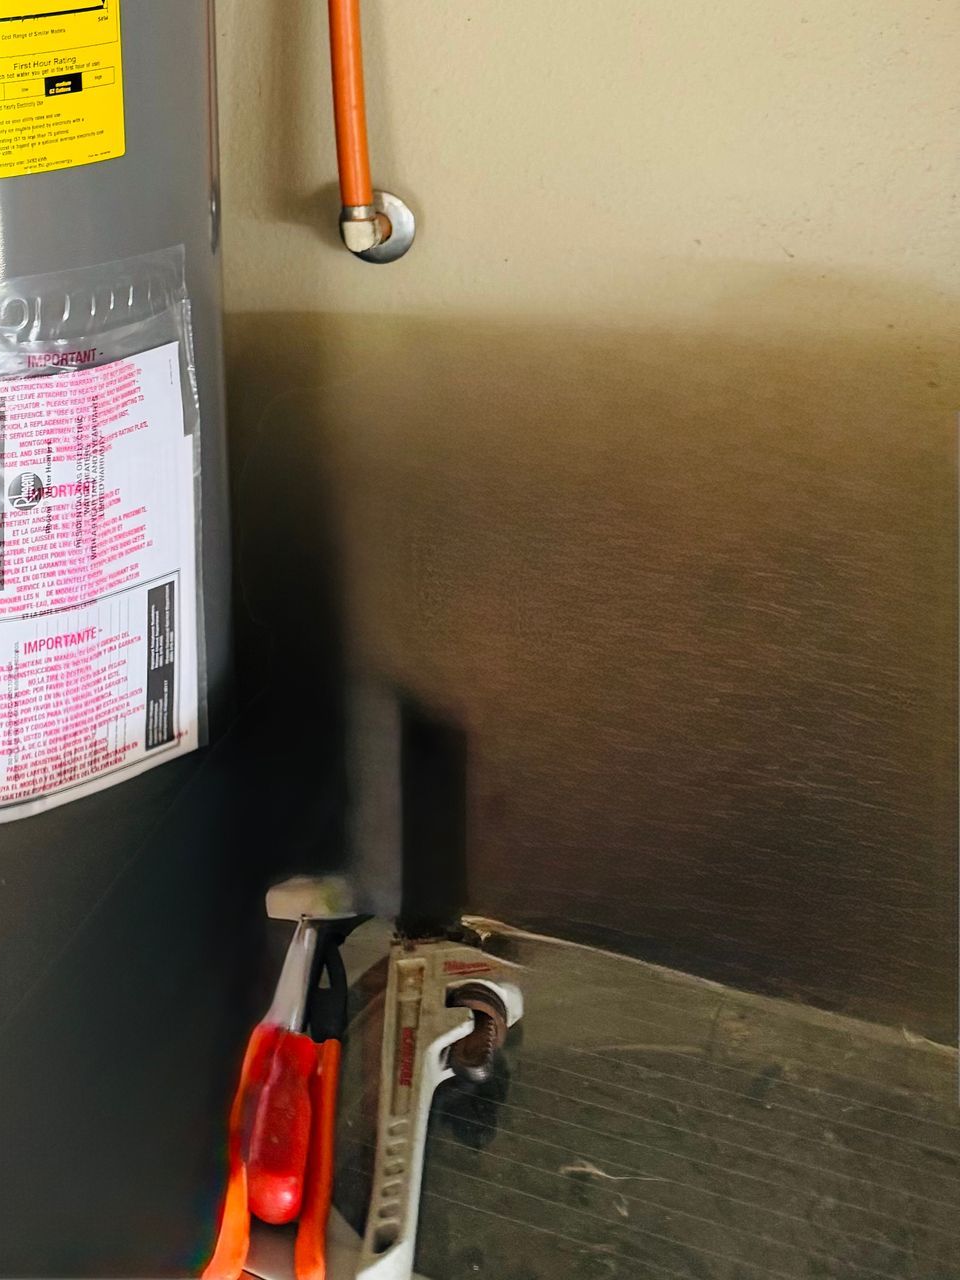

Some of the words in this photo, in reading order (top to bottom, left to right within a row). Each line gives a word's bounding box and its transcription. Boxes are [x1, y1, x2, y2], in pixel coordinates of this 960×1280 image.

[13, 62, 31, 70] First
[33, 60, 51, 68] Hour
[53, 56, 77, 66] Rating
[27, 348, 97, 369] IMPORTANT
[8, 472, 39, 508] Rheem
[16, 583, 40, 593] SERVICE
[47, 580, 55, 588] LA
[23, 594, 34, 602] LES
[46, 589, 54, 597] DE
[23, 626, 97, 655] IMPORTANTE
